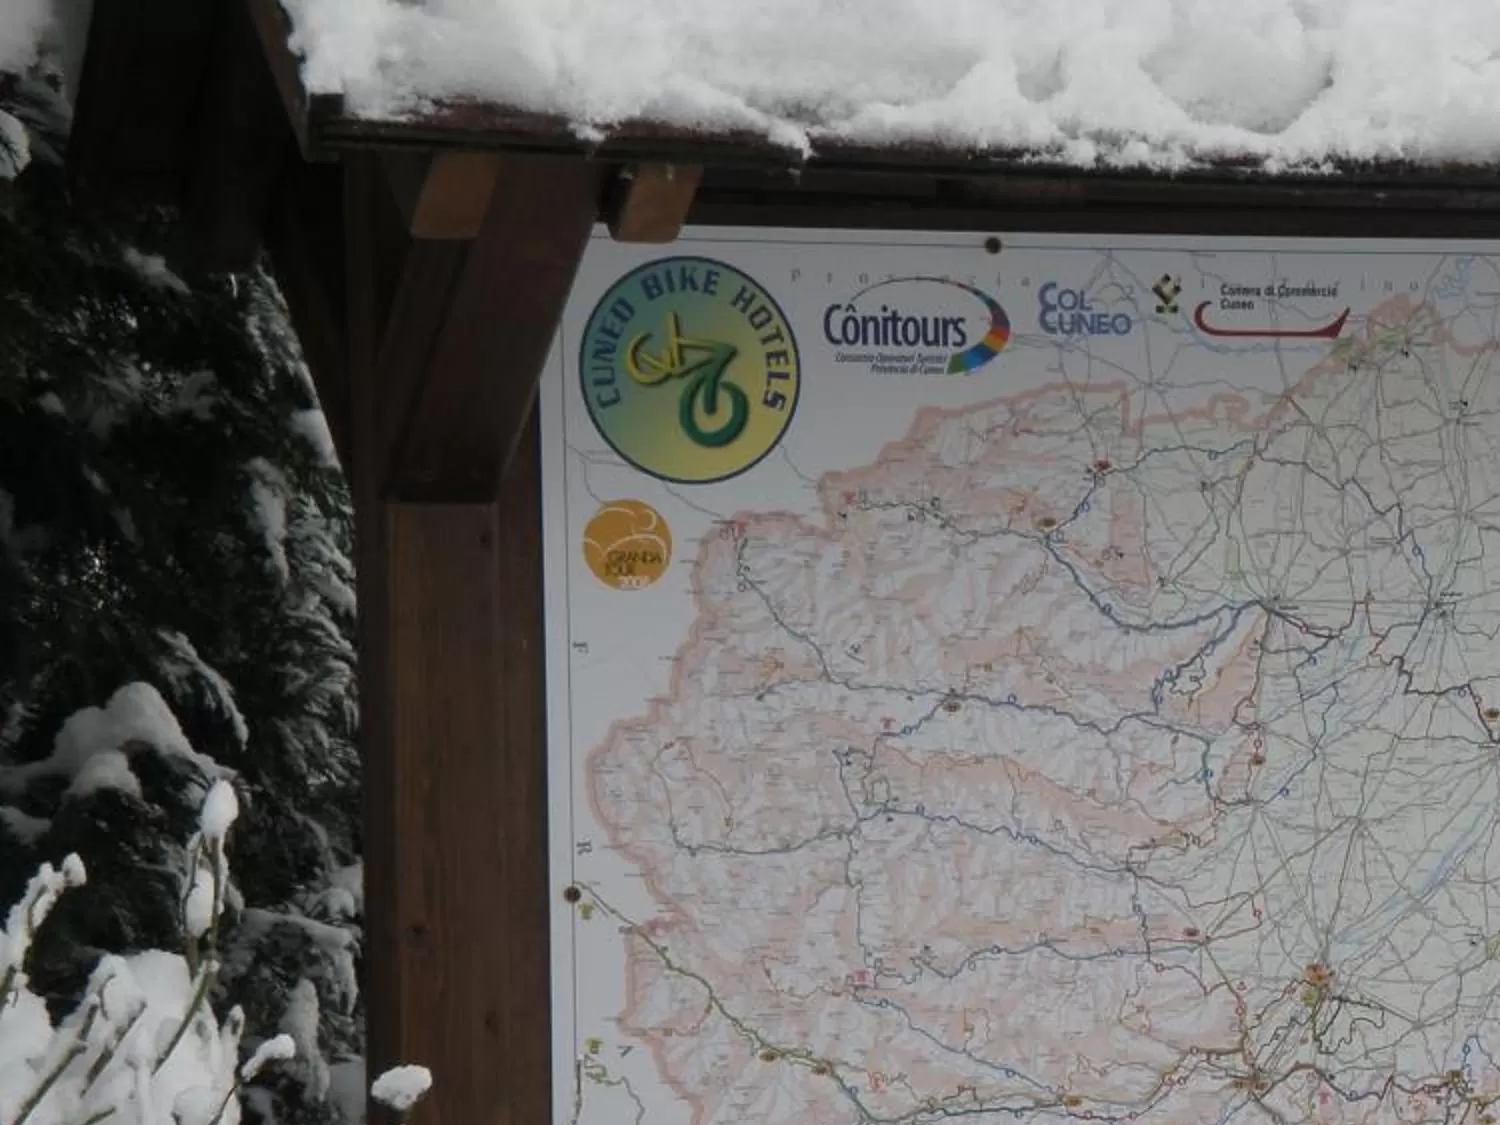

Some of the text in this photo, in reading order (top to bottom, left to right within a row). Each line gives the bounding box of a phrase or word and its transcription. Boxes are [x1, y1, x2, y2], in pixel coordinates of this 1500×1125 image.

[1038, 281, 1093, 311] COL
[1220, 299, 1255, 310] Cuneo
[823, 303, 968, 348] Cônitours
[1038, 310, 1132, 336] CUNEO
[592, 265, 790, 412] CUNEO BIKE HOTELS
